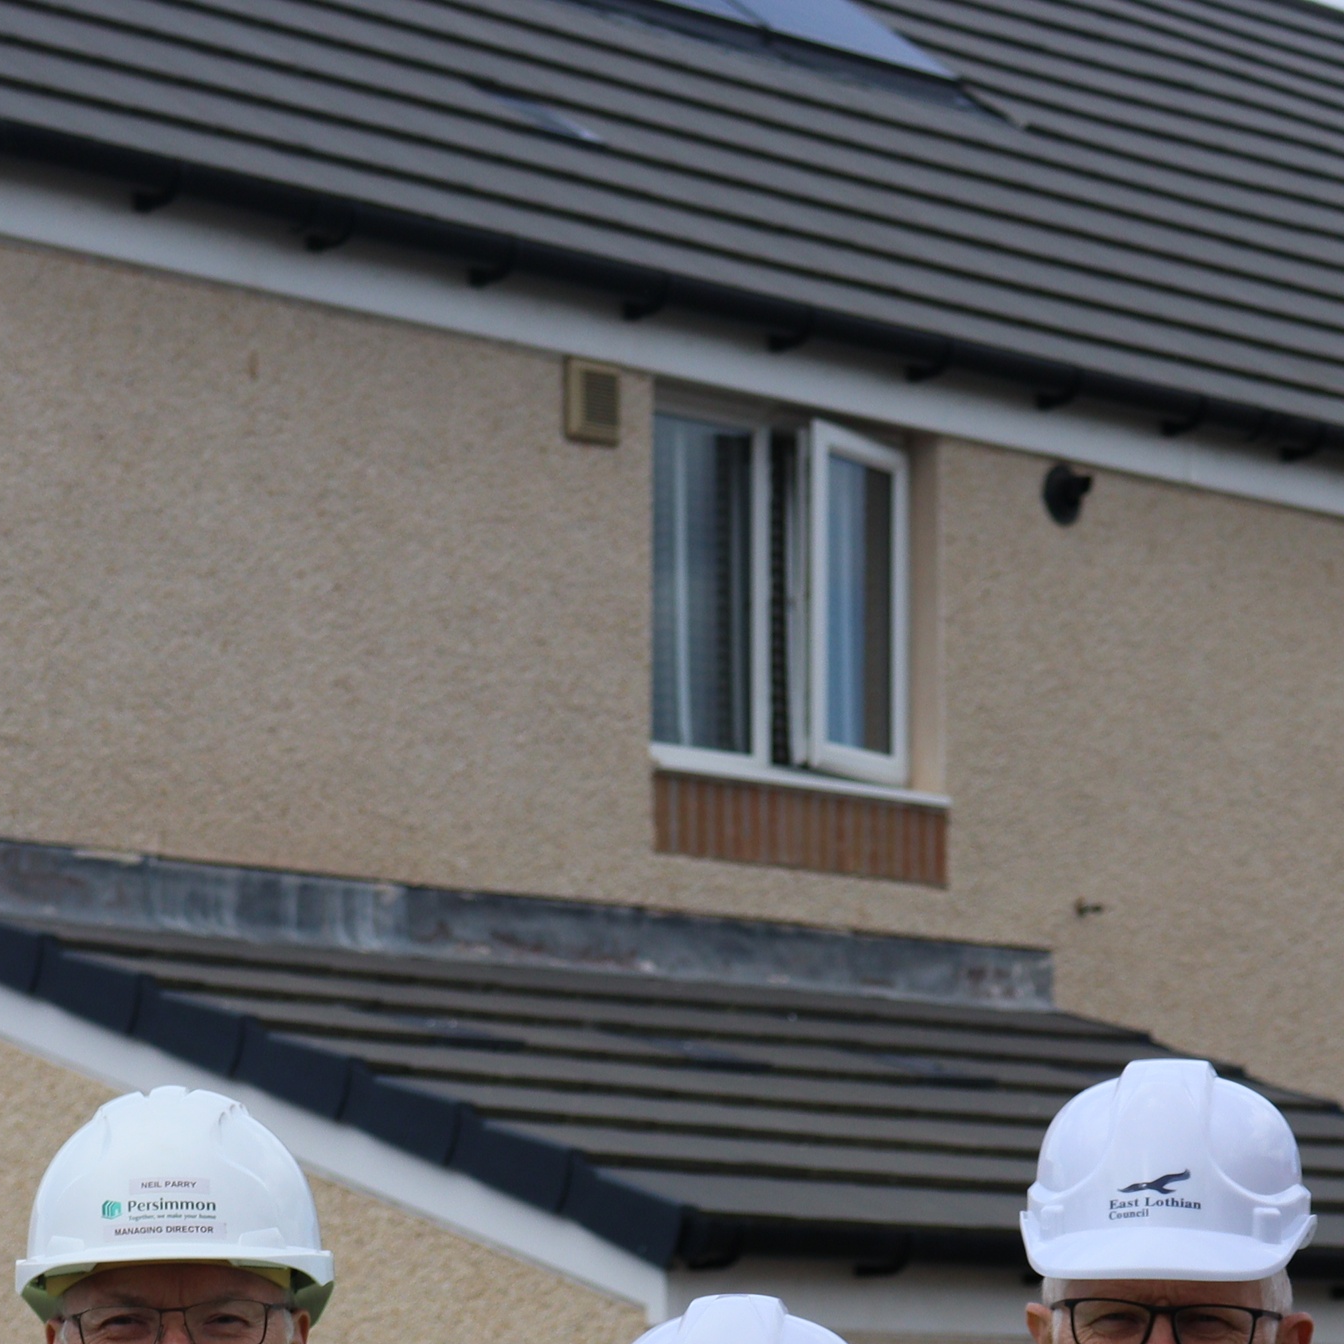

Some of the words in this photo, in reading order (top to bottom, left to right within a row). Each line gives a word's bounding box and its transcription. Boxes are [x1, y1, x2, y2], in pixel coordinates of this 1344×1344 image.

[141, 1181, 162, 1189] NEIL
[164, 1181, 197, 1189] PARRY
[128, 1197, 216, 1212] Persimmon
[1109, 1198, 1139, 1210] East
[1145, 1197, 1202, 1210] Lothian
[1109, 1209, 1149, 1220] Council
[114, 1226, 163, 1236] MANAGING
[165, 1225, 214, 1234] DIRECTOR
